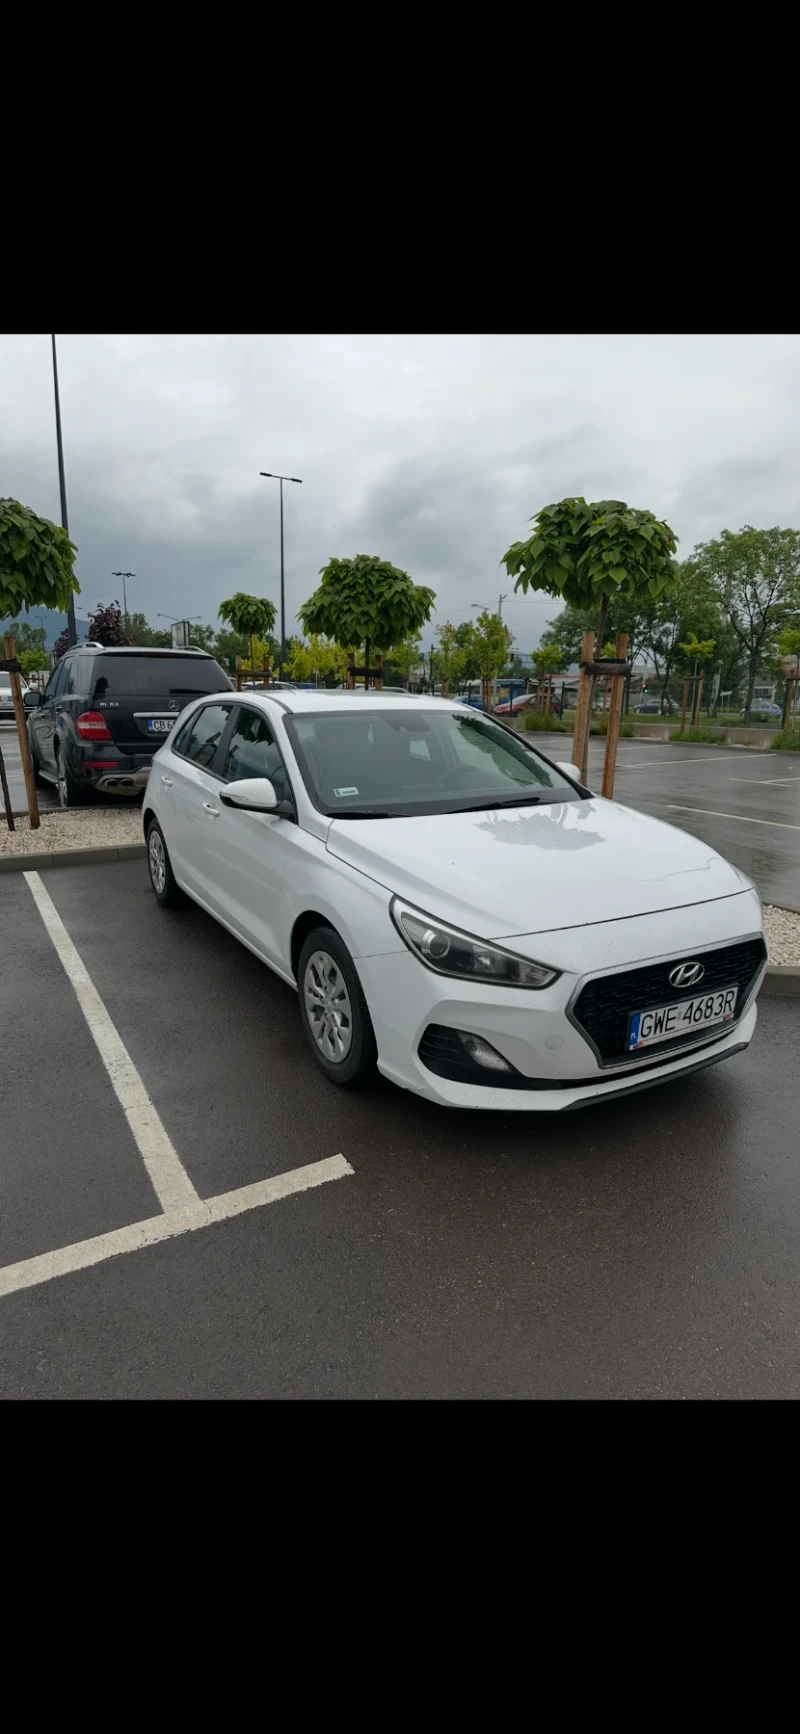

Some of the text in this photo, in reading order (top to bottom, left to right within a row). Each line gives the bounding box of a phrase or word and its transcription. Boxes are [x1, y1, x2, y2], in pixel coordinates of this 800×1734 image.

[153, 720, 166, 730] CB
[640, 990, 735, 1037] GWE 4683R
